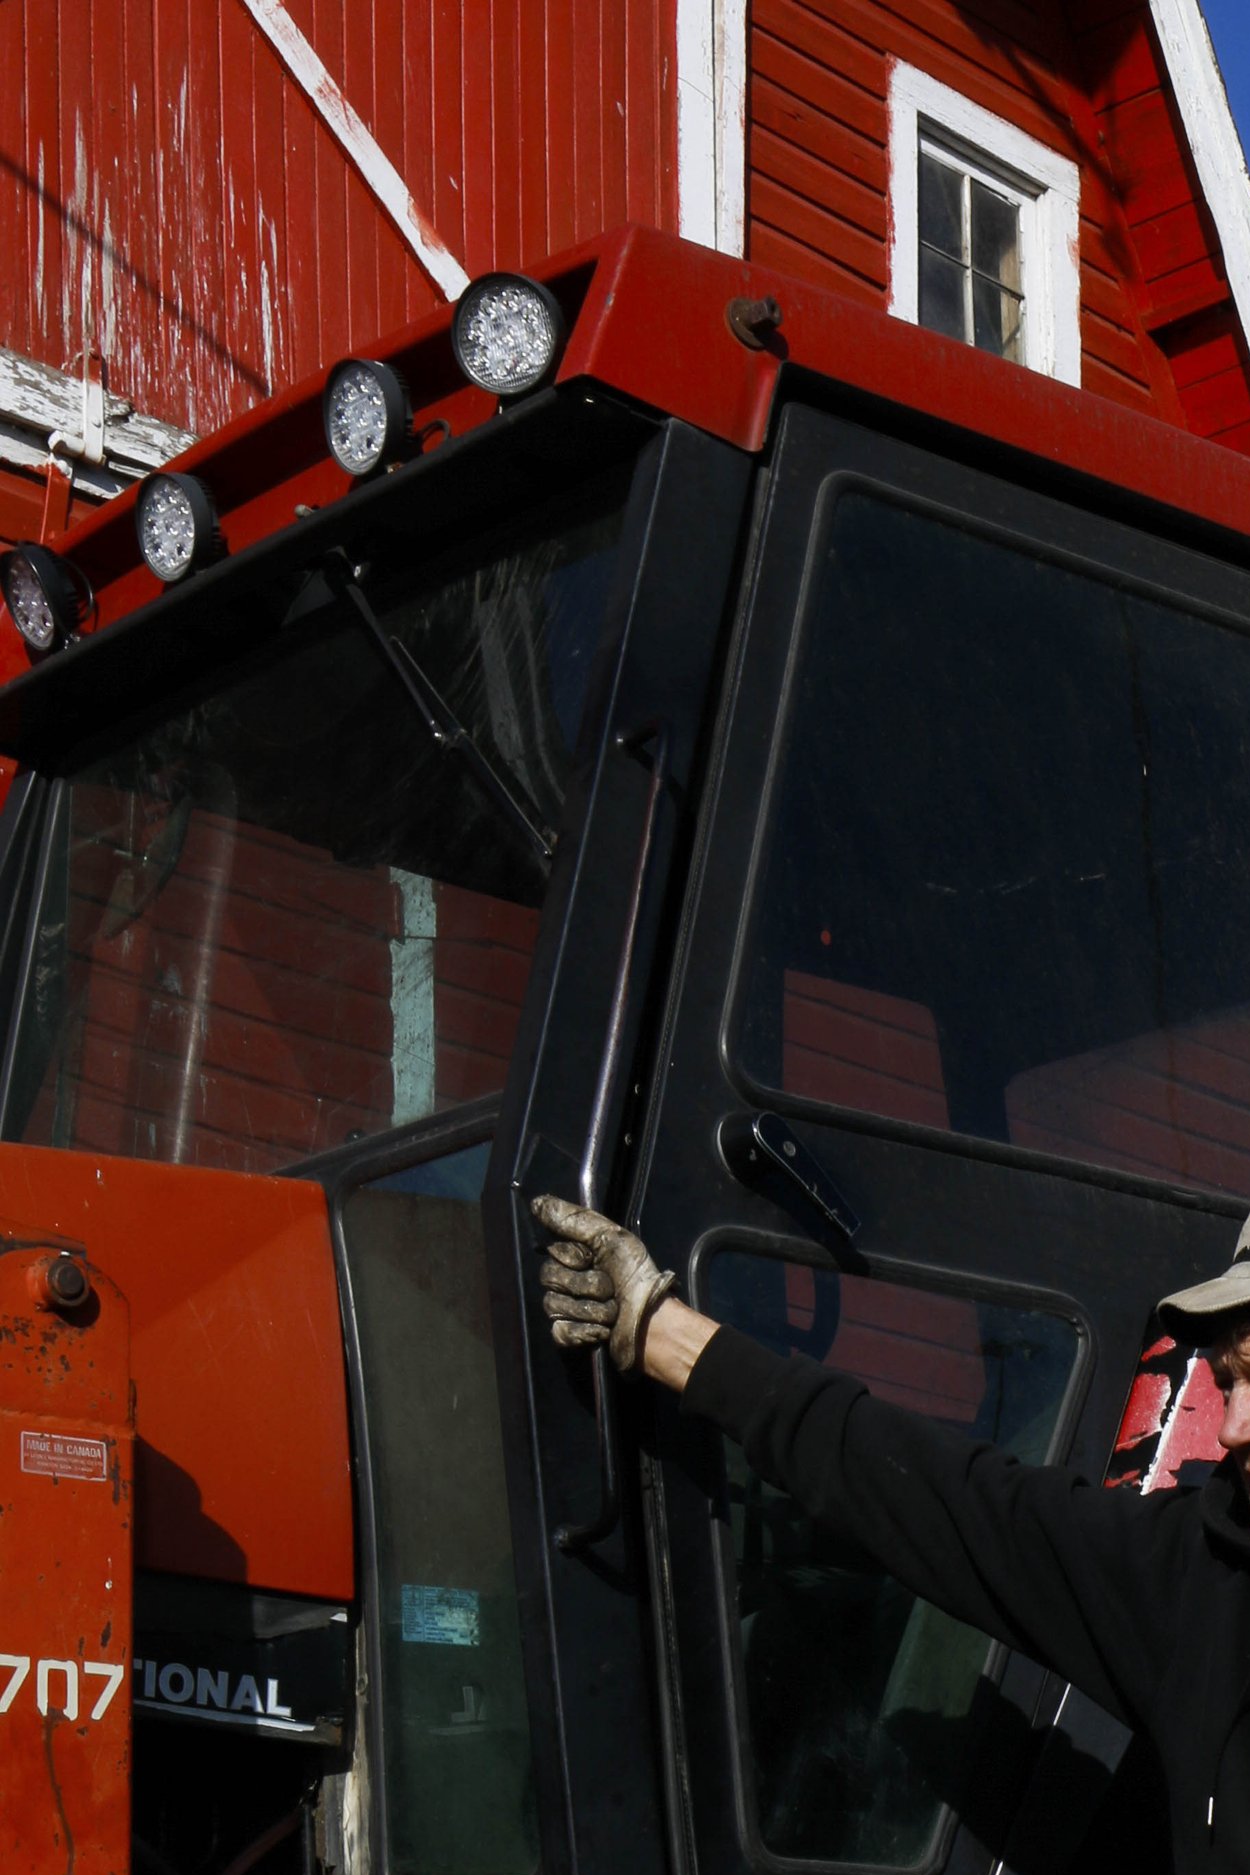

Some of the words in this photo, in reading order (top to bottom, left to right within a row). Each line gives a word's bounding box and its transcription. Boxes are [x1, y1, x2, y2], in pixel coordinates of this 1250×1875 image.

[26, 1439, 51, 1452] MADE
[54, 1443, 63, 1453] IN
[67, 1444, 101, 1458] CANADA
